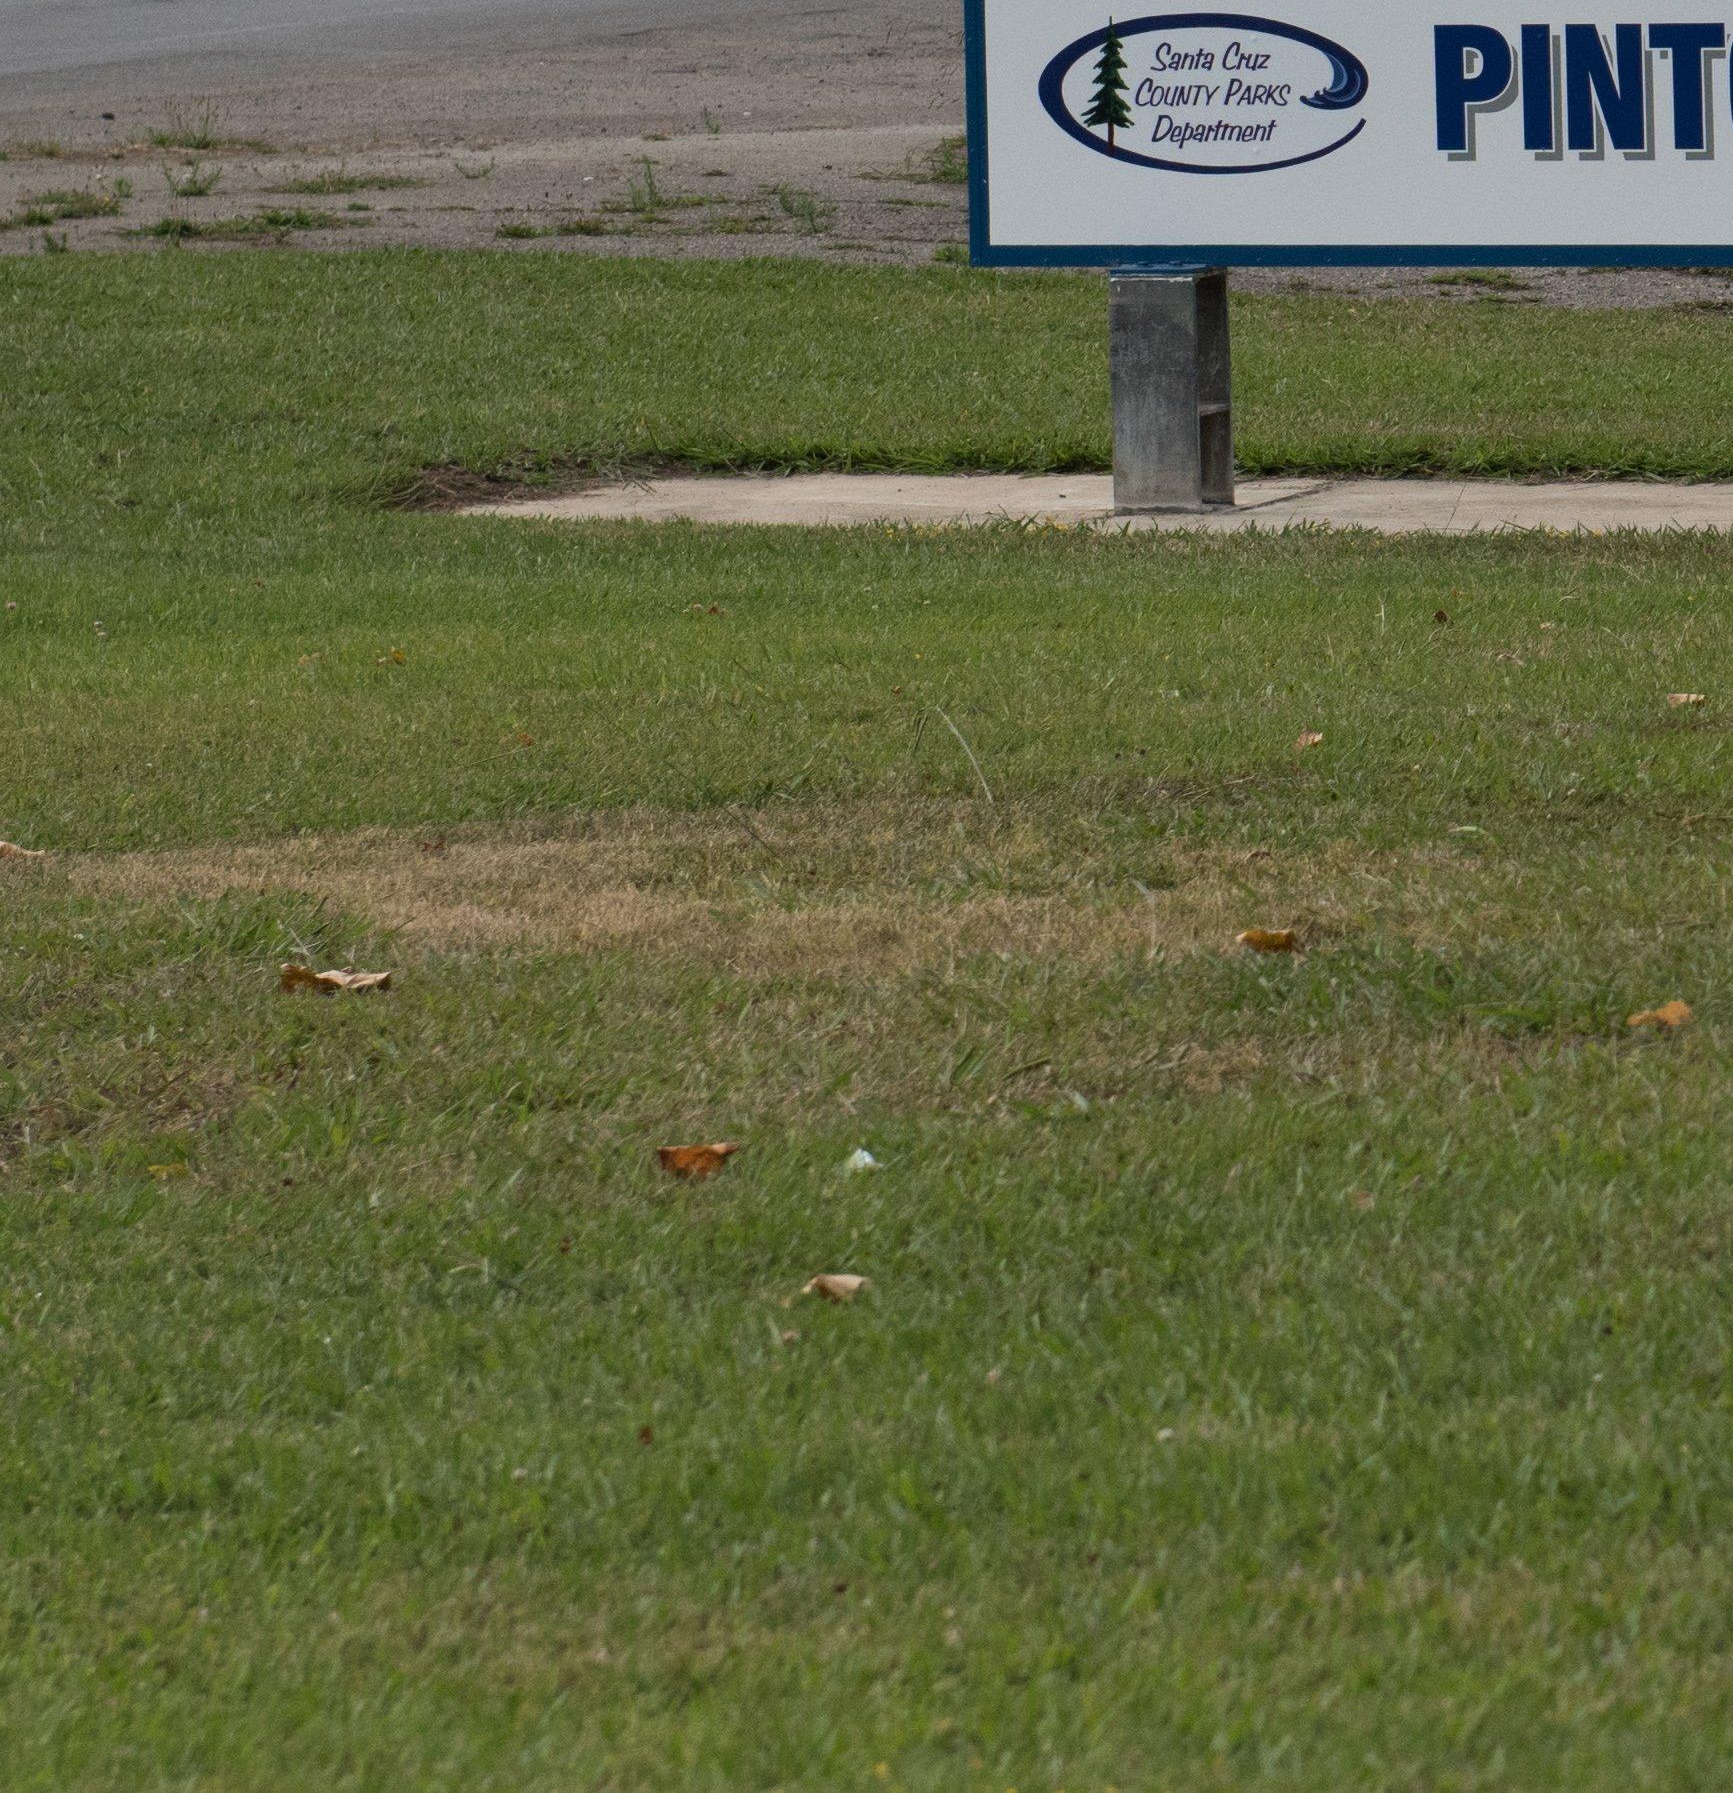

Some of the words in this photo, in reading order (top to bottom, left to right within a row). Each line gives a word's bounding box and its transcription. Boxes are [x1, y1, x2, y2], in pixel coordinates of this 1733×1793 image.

[1150, 42, 1215, 72] Santa
[1222, 41, 1271, 71] Cruz
[1135, 77, 1220, 106] COUNTY
[1223, 78, 1291, 106] PARKS
[1151, 114, 1277, 149] Department
